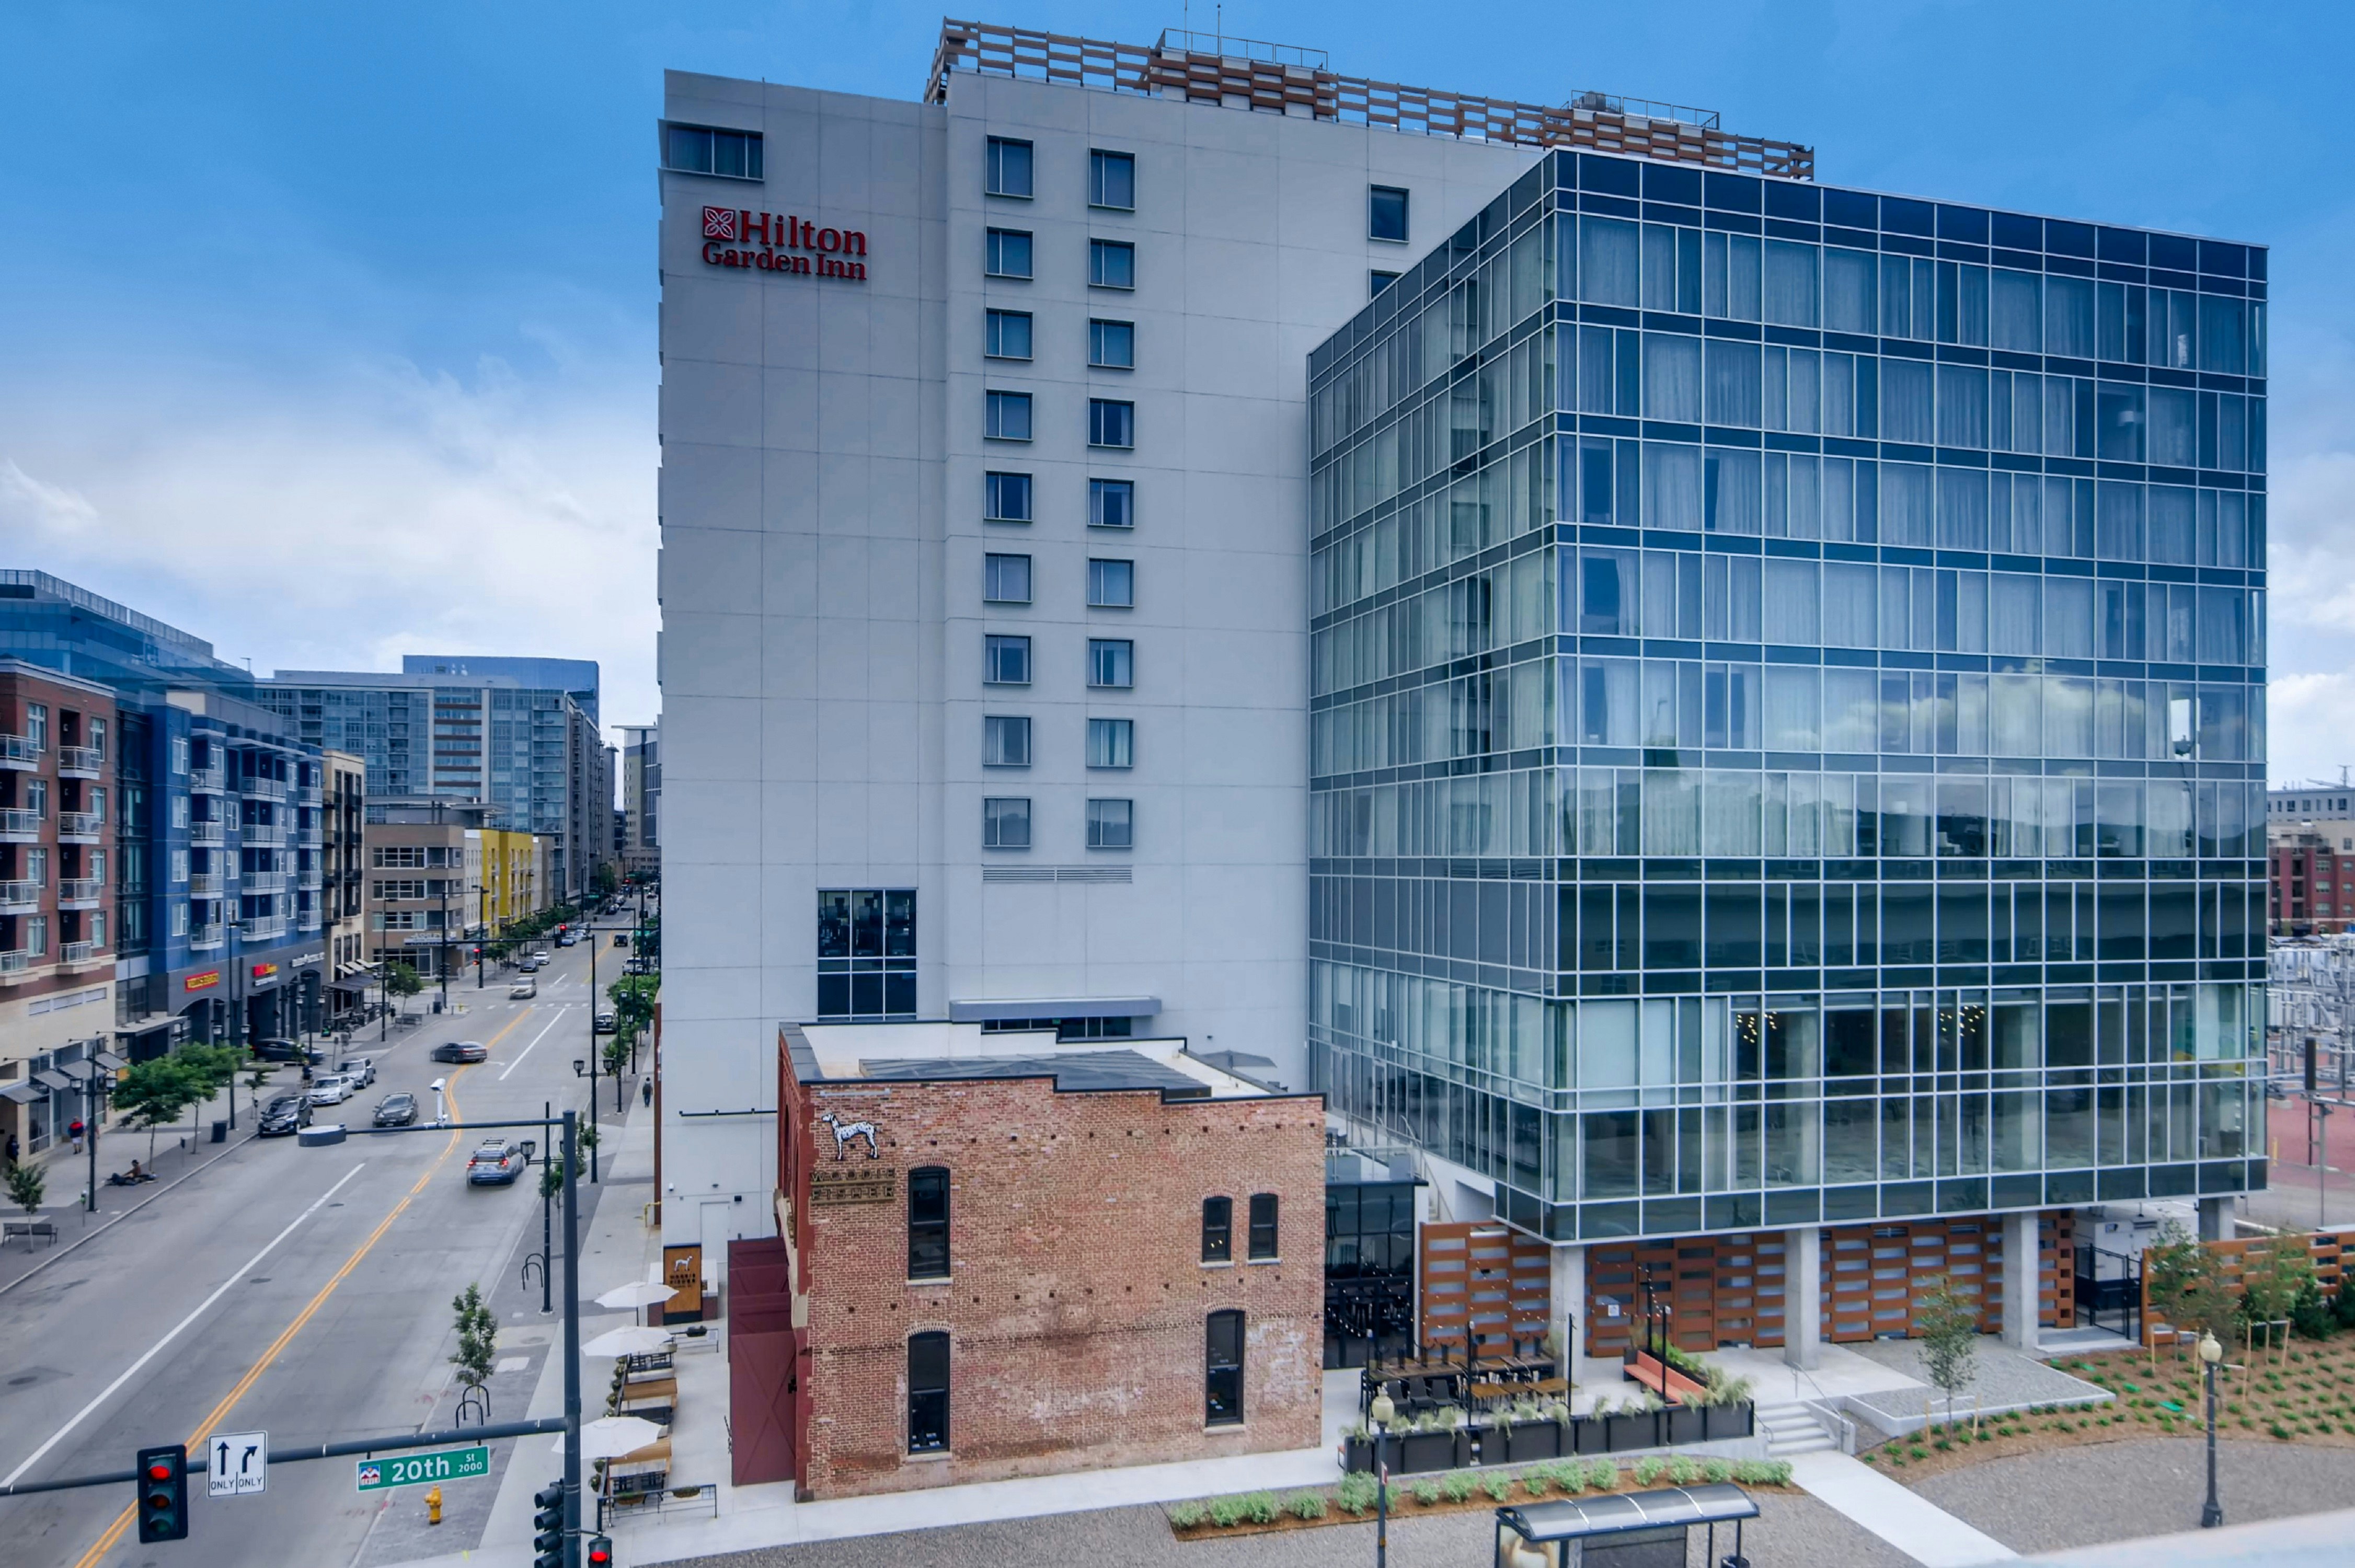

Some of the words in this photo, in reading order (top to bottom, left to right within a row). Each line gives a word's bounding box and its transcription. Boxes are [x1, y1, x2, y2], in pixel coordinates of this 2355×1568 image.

[739, 210, 867, 256] Hilton
[702, 241, 811, 274] Garden
[815, 253, 867, 280] Inn
[811, 1168, 895, 1182] WOODIE
[812, 1186, 894, 1201] FISHER
[392, 1456, 450, 1482] 20th
[466, 1454, 475, 1462] St
[458, 1461, 483, 1473] 2000
[211, 1480, 235, 1490] ONLY
[238, 1477, 262, 1488] ONLY
